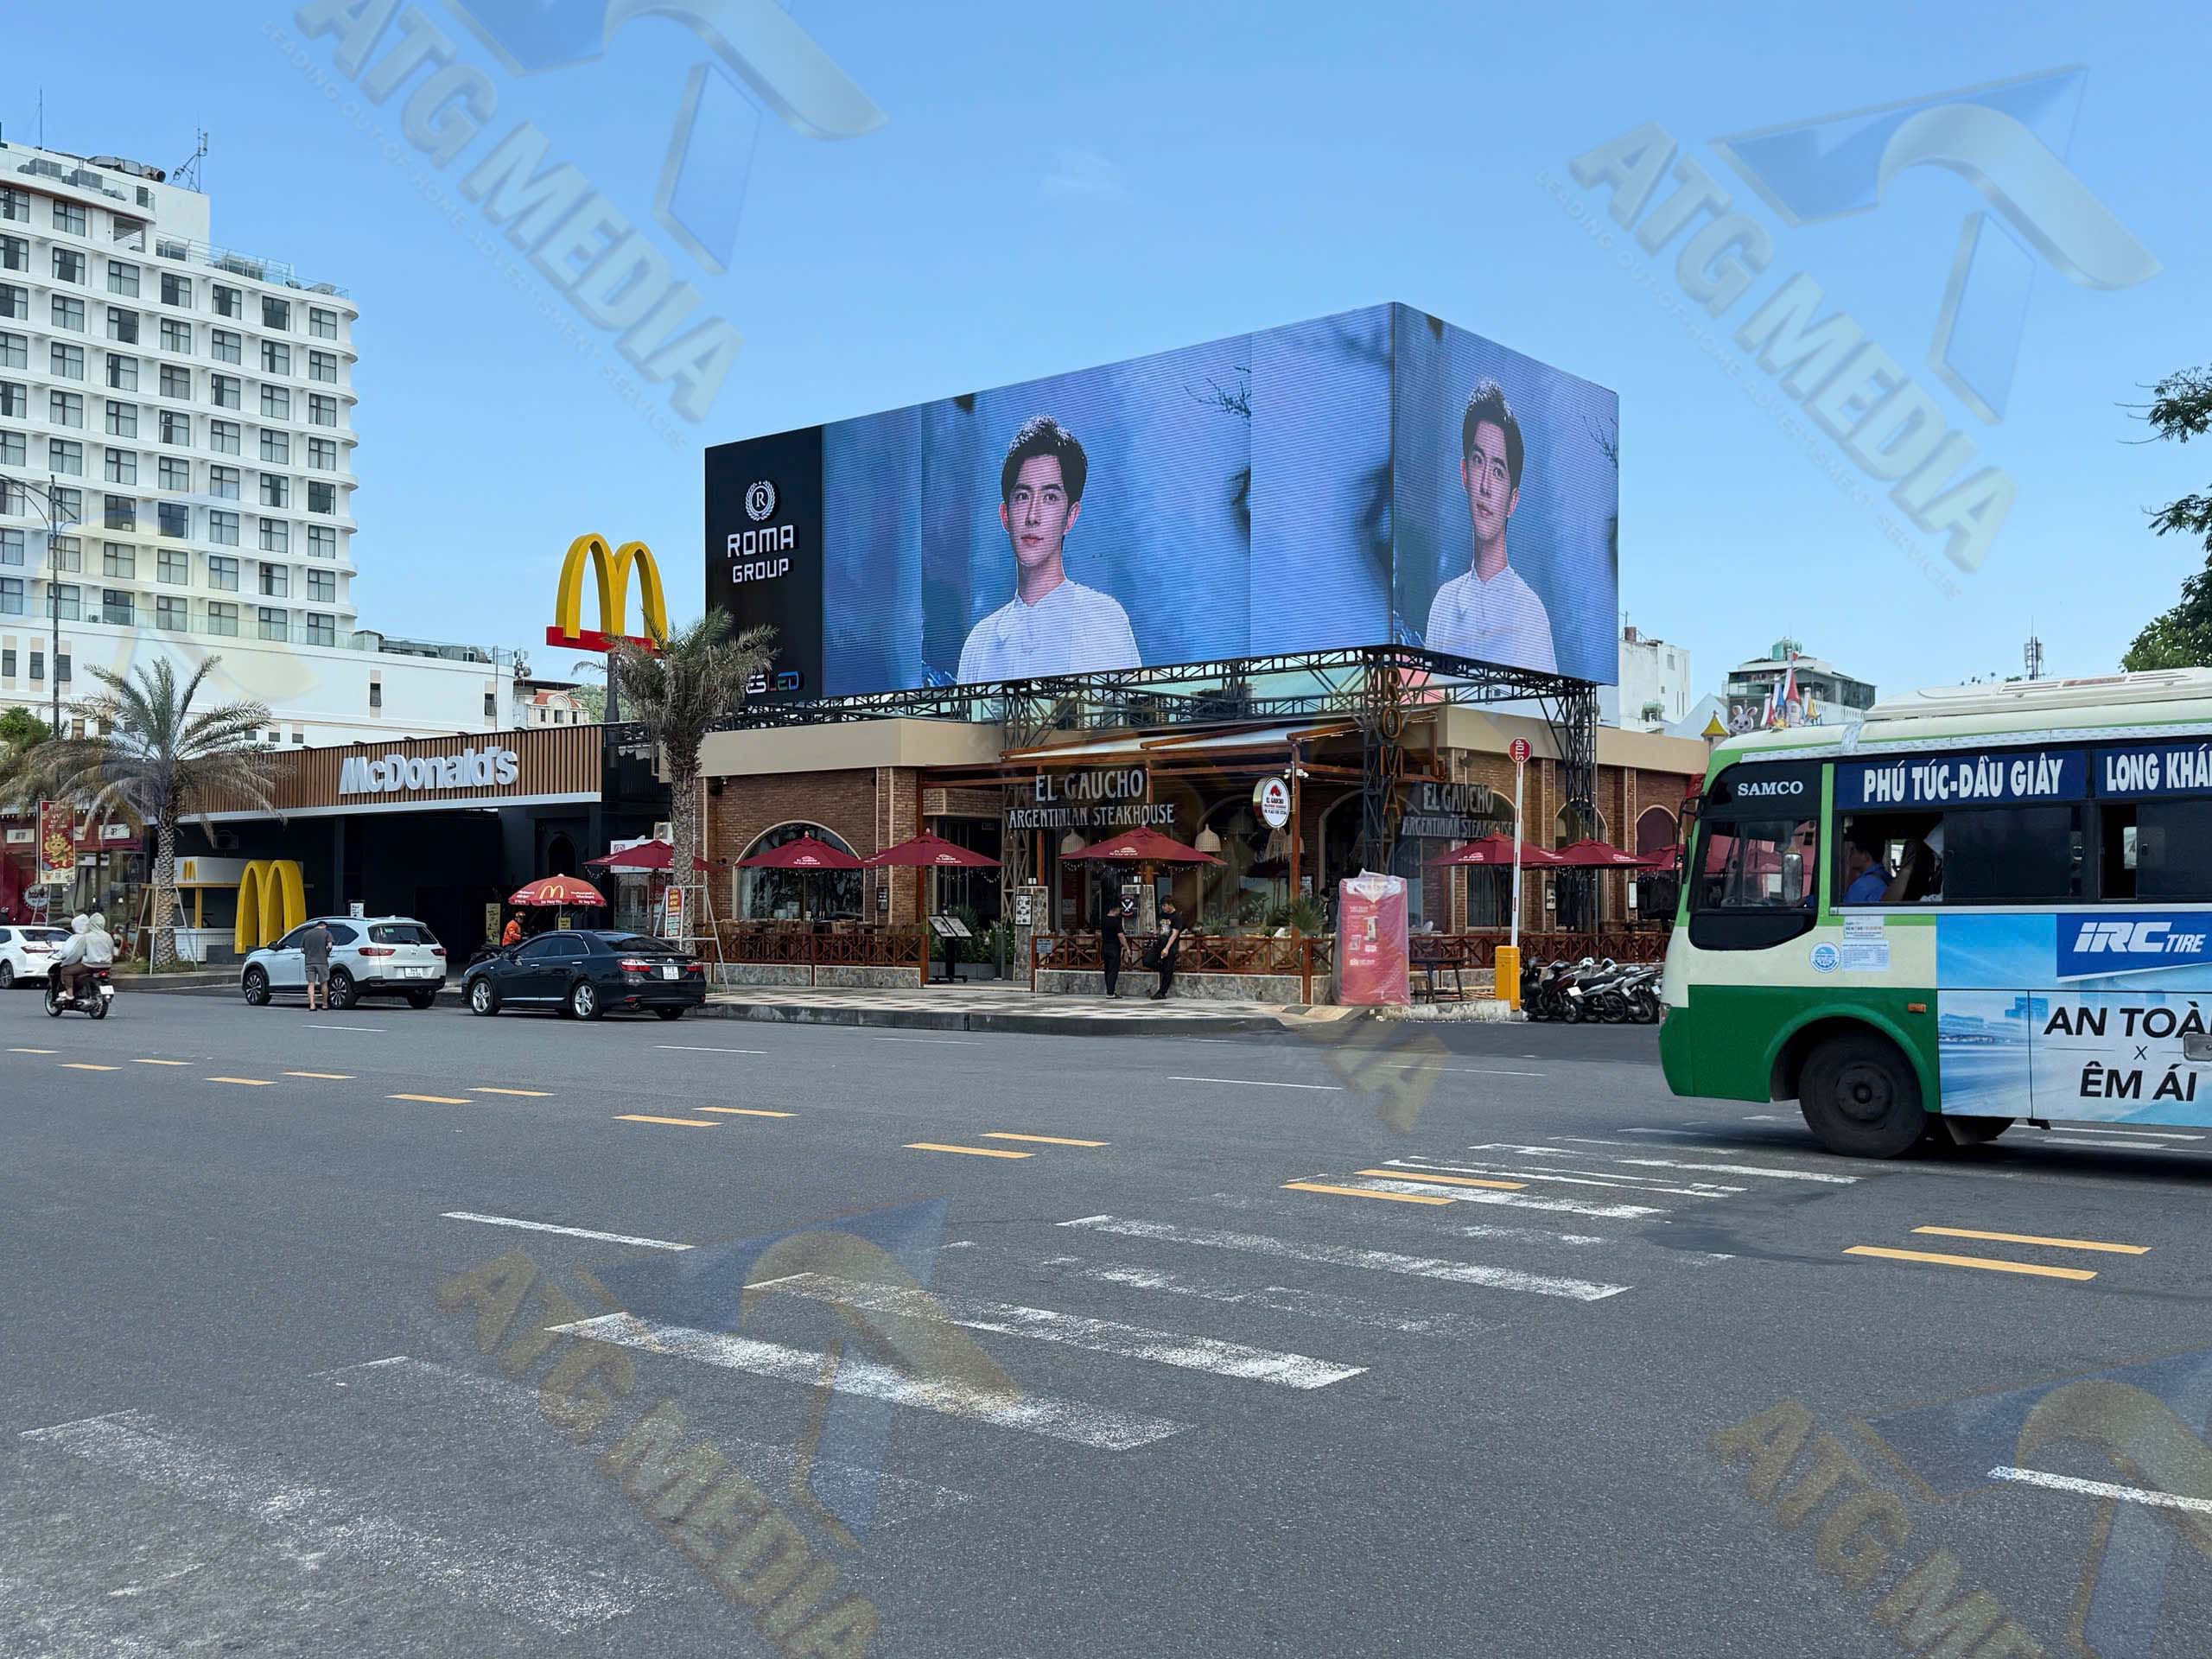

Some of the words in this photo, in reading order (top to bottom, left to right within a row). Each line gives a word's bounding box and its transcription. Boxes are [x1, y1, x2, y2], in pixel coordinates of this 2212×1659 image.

[727, 524, 795, 558] ROMA
[733, 557, 790, 583] GROUP
[1515, 739, 1525, 761] STOP
[339, 746, 518, 794] McDonald's
[1863, 760, 1906, 802] PHÚ
[2010, 752, 2063, 797] GIÂY
[2107, 753, 2160, 791] LONG
[2166, 743, 2212, 788] KHÁ
[1035, 774, 1058, 802] EL
[1064, 769, 1144, 800] GAUCHO
[1423, 783, 1440, 811] EL
[1441, 784, 1494, 815] GAUCHO
[1737, 780, 1804, 797] SAMCO
[1008, 807, 1089, 830] ARGENTINIAN
[1092, 804, 1176, 827] STEAKHOUSE
[2165, 934, 2206, 953] TIRE
[2044, 1007, 2108, 1036] AN
[2119, 1001, 2212, 1039] TOÀ
[2080, 1061, 2144, 1100] ÊM
[2152, 1063, 2197, 1102] ÁI
